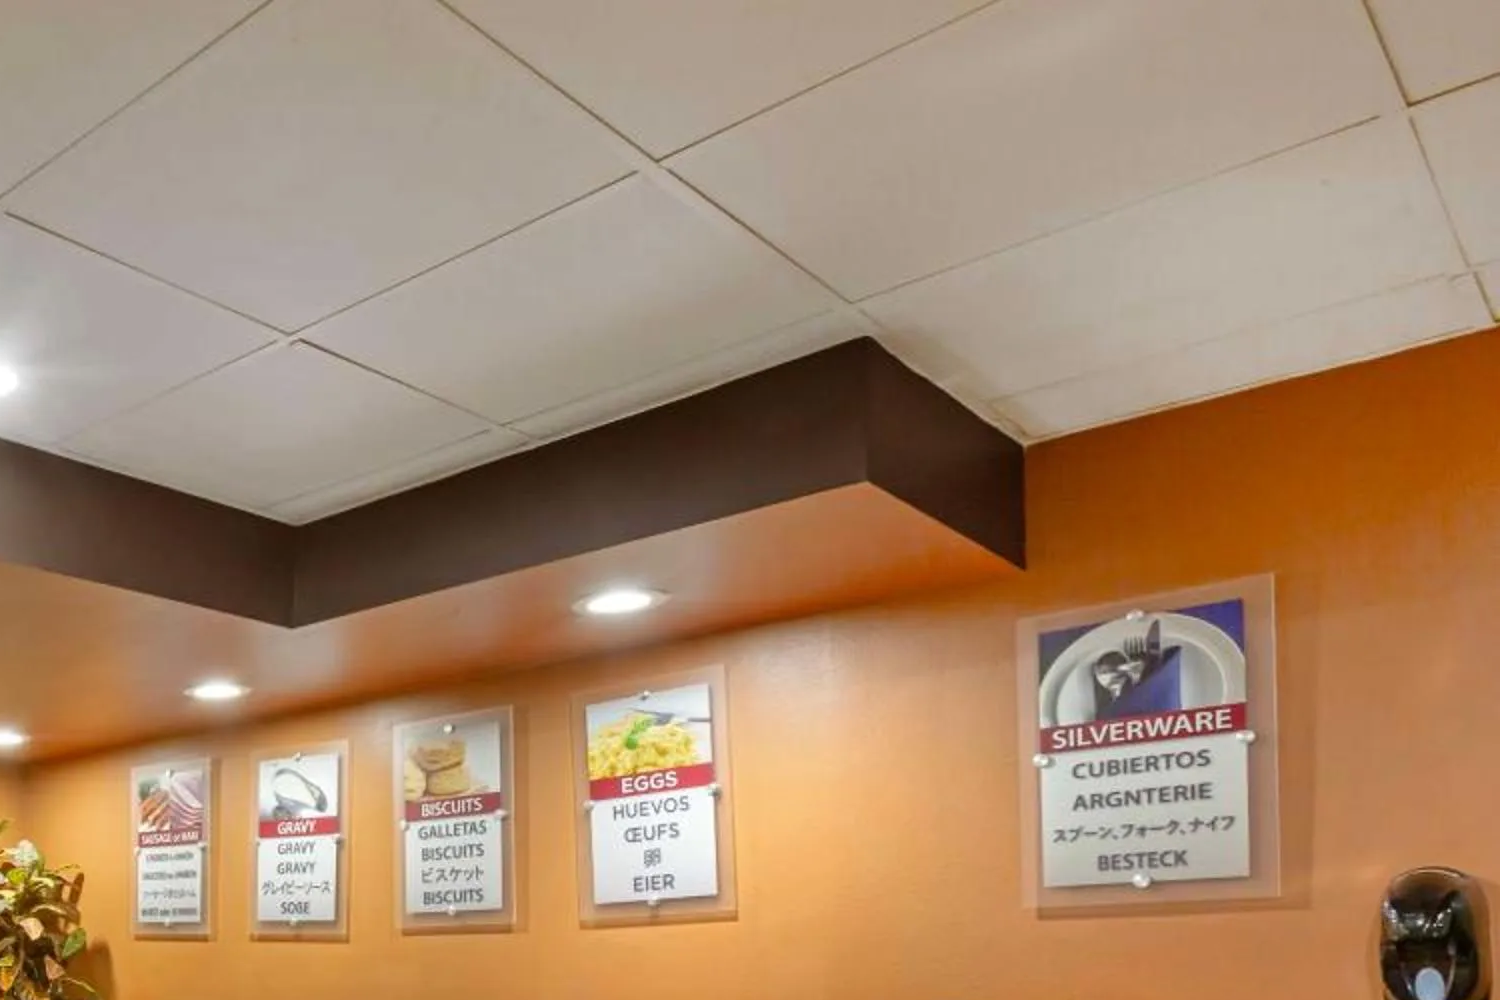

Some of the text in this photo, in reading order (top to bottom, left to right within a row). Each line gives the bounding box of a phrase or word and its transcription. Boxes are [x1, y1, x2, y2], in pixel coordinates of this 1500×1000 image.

[1053, 708, 1232, 749] SILVERWARE
[1072, 749, 1211, 779] CUBIERTOS
[621, 771, 677, 794] EGGS
[1072, 782, 1213, 811] ARGNTERIE
[422, 798, 483, 817] BISCUITS
[613, 795, 690, 821] HUEVOS
[278, 820, 316, 835] GRAVY
[418, 820, 487, 840] GALLETAS
[624, 822, 680, 843] ŒUFS
[278, 841, 315, 855] GRAVY
[421, 843, 484, 861] BISCUITS
[277, 861, 315, 875] GRAVY
[1098, 850, 1188, 872] BESTECK
[633, 873, 675, 893] EIER
[423, 888, 484, 905] BISCUITS
